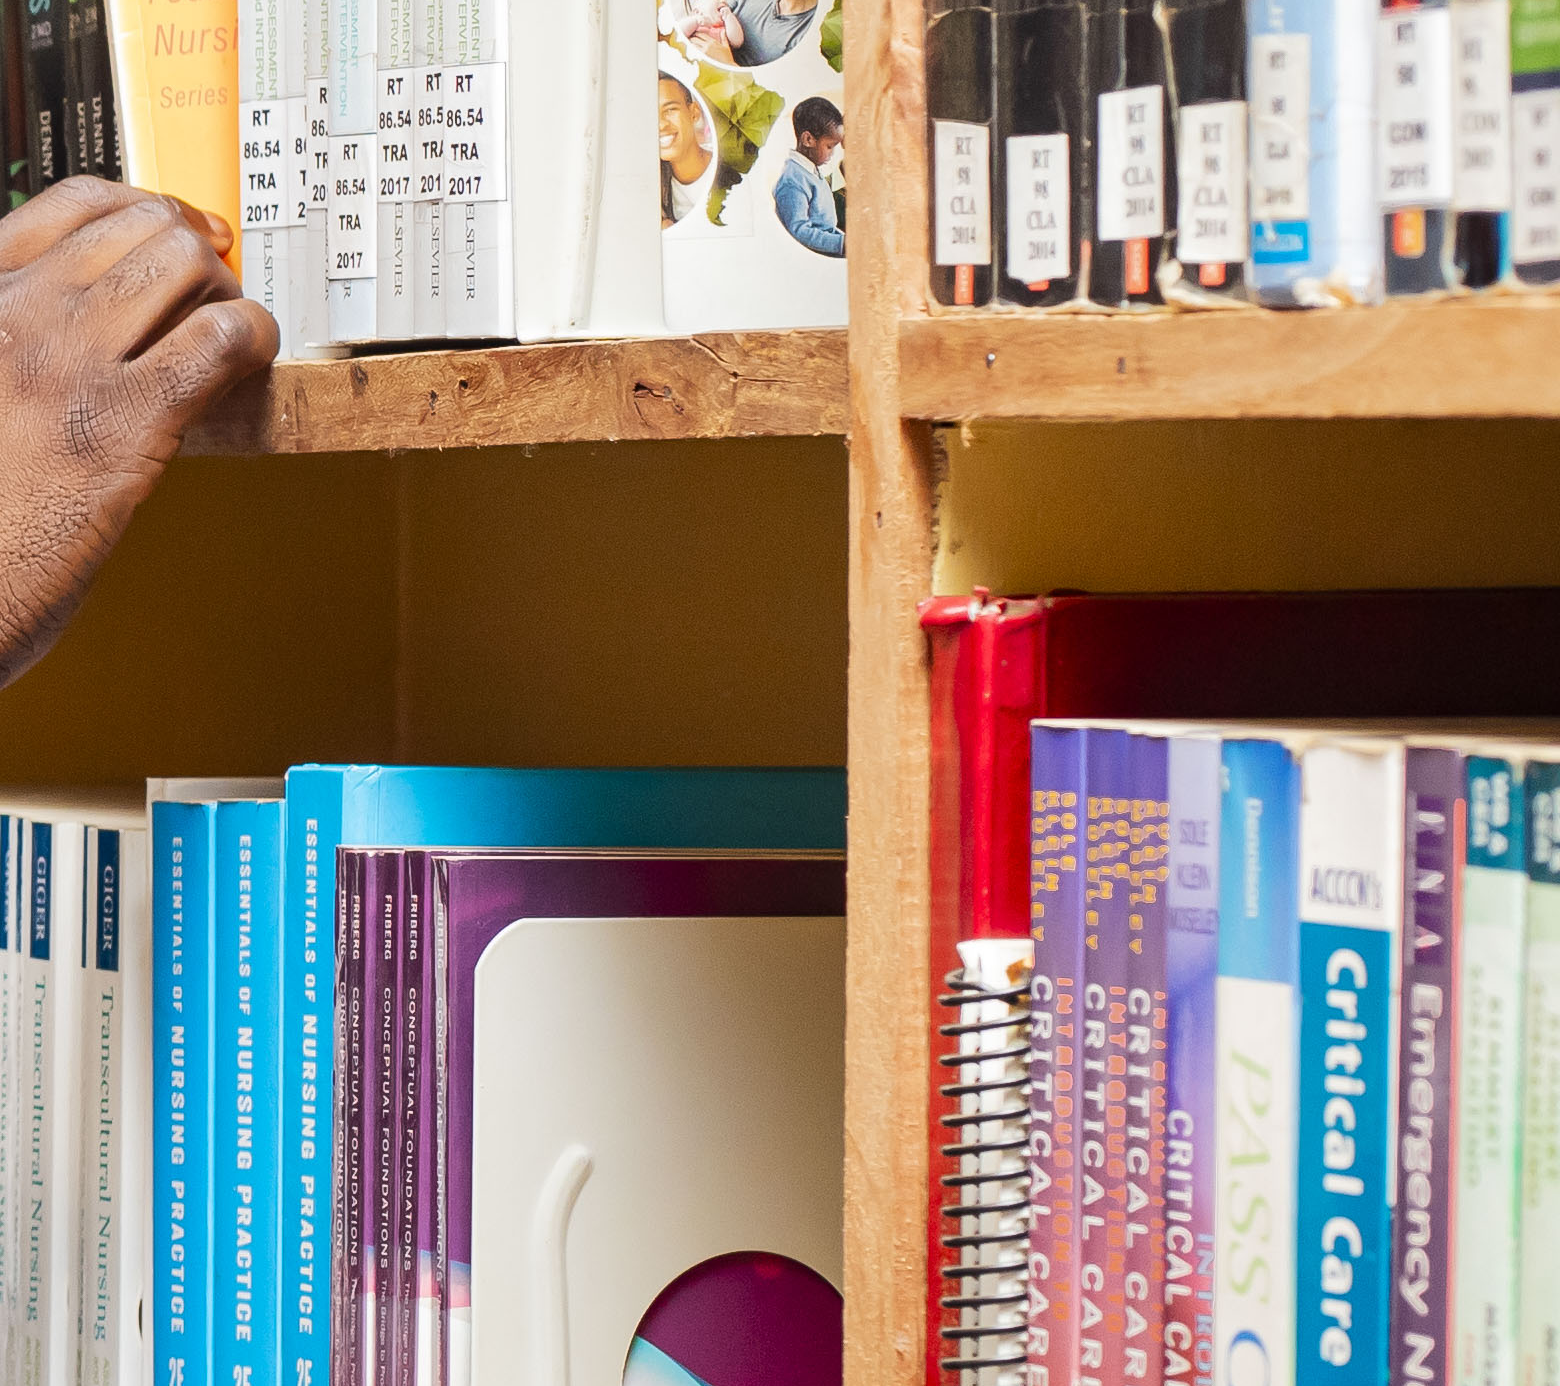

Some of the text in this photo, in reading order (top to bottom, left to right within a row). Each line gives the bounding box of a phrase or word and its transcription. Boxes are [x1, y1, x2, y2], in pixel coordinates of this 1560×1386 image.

[455, 75, 473, 93] RT
[160, 84, 228, 109] Series
[253, 110, 270, 126] RT
[446, 108, 483, 127] 86.54
[1126, 104, 1147, 125] RT
[244, 140, 280, 158] 86.54
[343, 144, 358, 160] RT
[451, 143, 478, 161] TRA
[1129, 134, 1146, 155] 98
[248, 174, 276, 190] TRA
[449, 177, 481, 195] 2017
[1122, 165, 1154, 187] CLA
[335, 179, 366, 196] 86.54
[246, 204, 278, 222] 2017
[1126, 196, 1155, 218] 2014
[339, 215, 361, 231] TRA
[336, 252, 363, 268] 2017
[239, 834, 250, 978] ESSENTIALS
[384, 894, 392, 961] FRIBERG
[239, 987, 250, 1016] OF
[1324, 948, 1368, 1197] Critical
[236, 1027, 253, 1170] NURSING
[1081, 982, 1106, 1241] CRITICAL
[380, 987, 391, 1270] CONCEPTUAL FOUNDATIONS
[1399, 982, 1443, 1317] Emergency
[1227, 1048, 1273, 1305] PASS
[1164, 1109, 1194, 1305] CRITICAL
[235, 1185, 253, 1342] PRACTICE
[1320, 1215, 1364, 1366] Care
